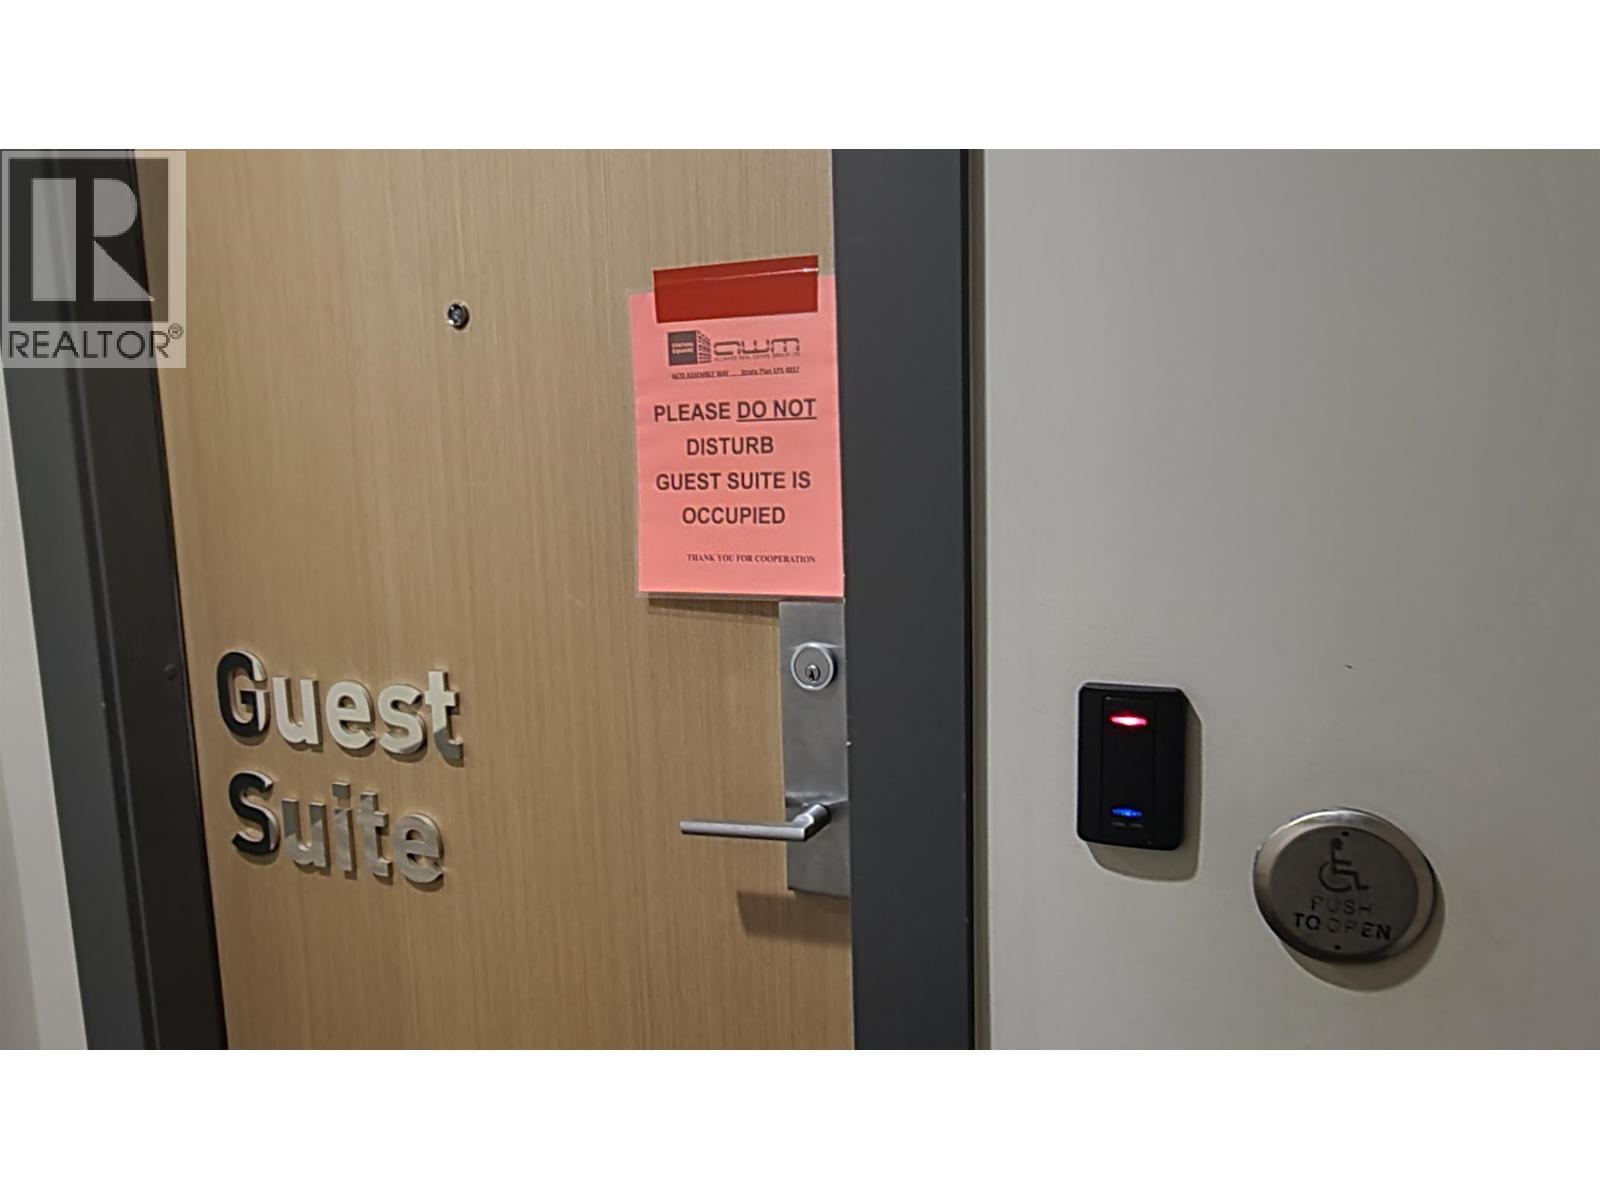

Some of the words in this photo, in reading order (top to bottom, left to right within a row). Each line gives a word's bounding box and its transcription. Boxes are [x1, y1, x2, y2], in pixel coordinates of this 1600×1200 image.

[654, 402, 731, 422] PLEASE
[736, 400, 767, 420] DO
[773, 398, 817, 418] NOT
[686, 436, 774, 456] DISTURB
[656, 473, 721, 491] GUEST
[727, 472, 786, 490] SUITE
[792, 471, 811, 489] IS
[682, 506, 786, 525] OCCUPIED
[687, 553, 715, 562] THANK
[717, 554, 735, 562] YOU
[736, 554, 753, 562] FOR
[754, 554, 816, 563] COOPERATION
[216, 649, 464, 763] Guest
[229, 770, 445, 885] Suite
[1311, 896, 1373, 916] PUSH
[1294, 913, 1322, 930] TO
[1326, 917, 1392, 941] OPEN
